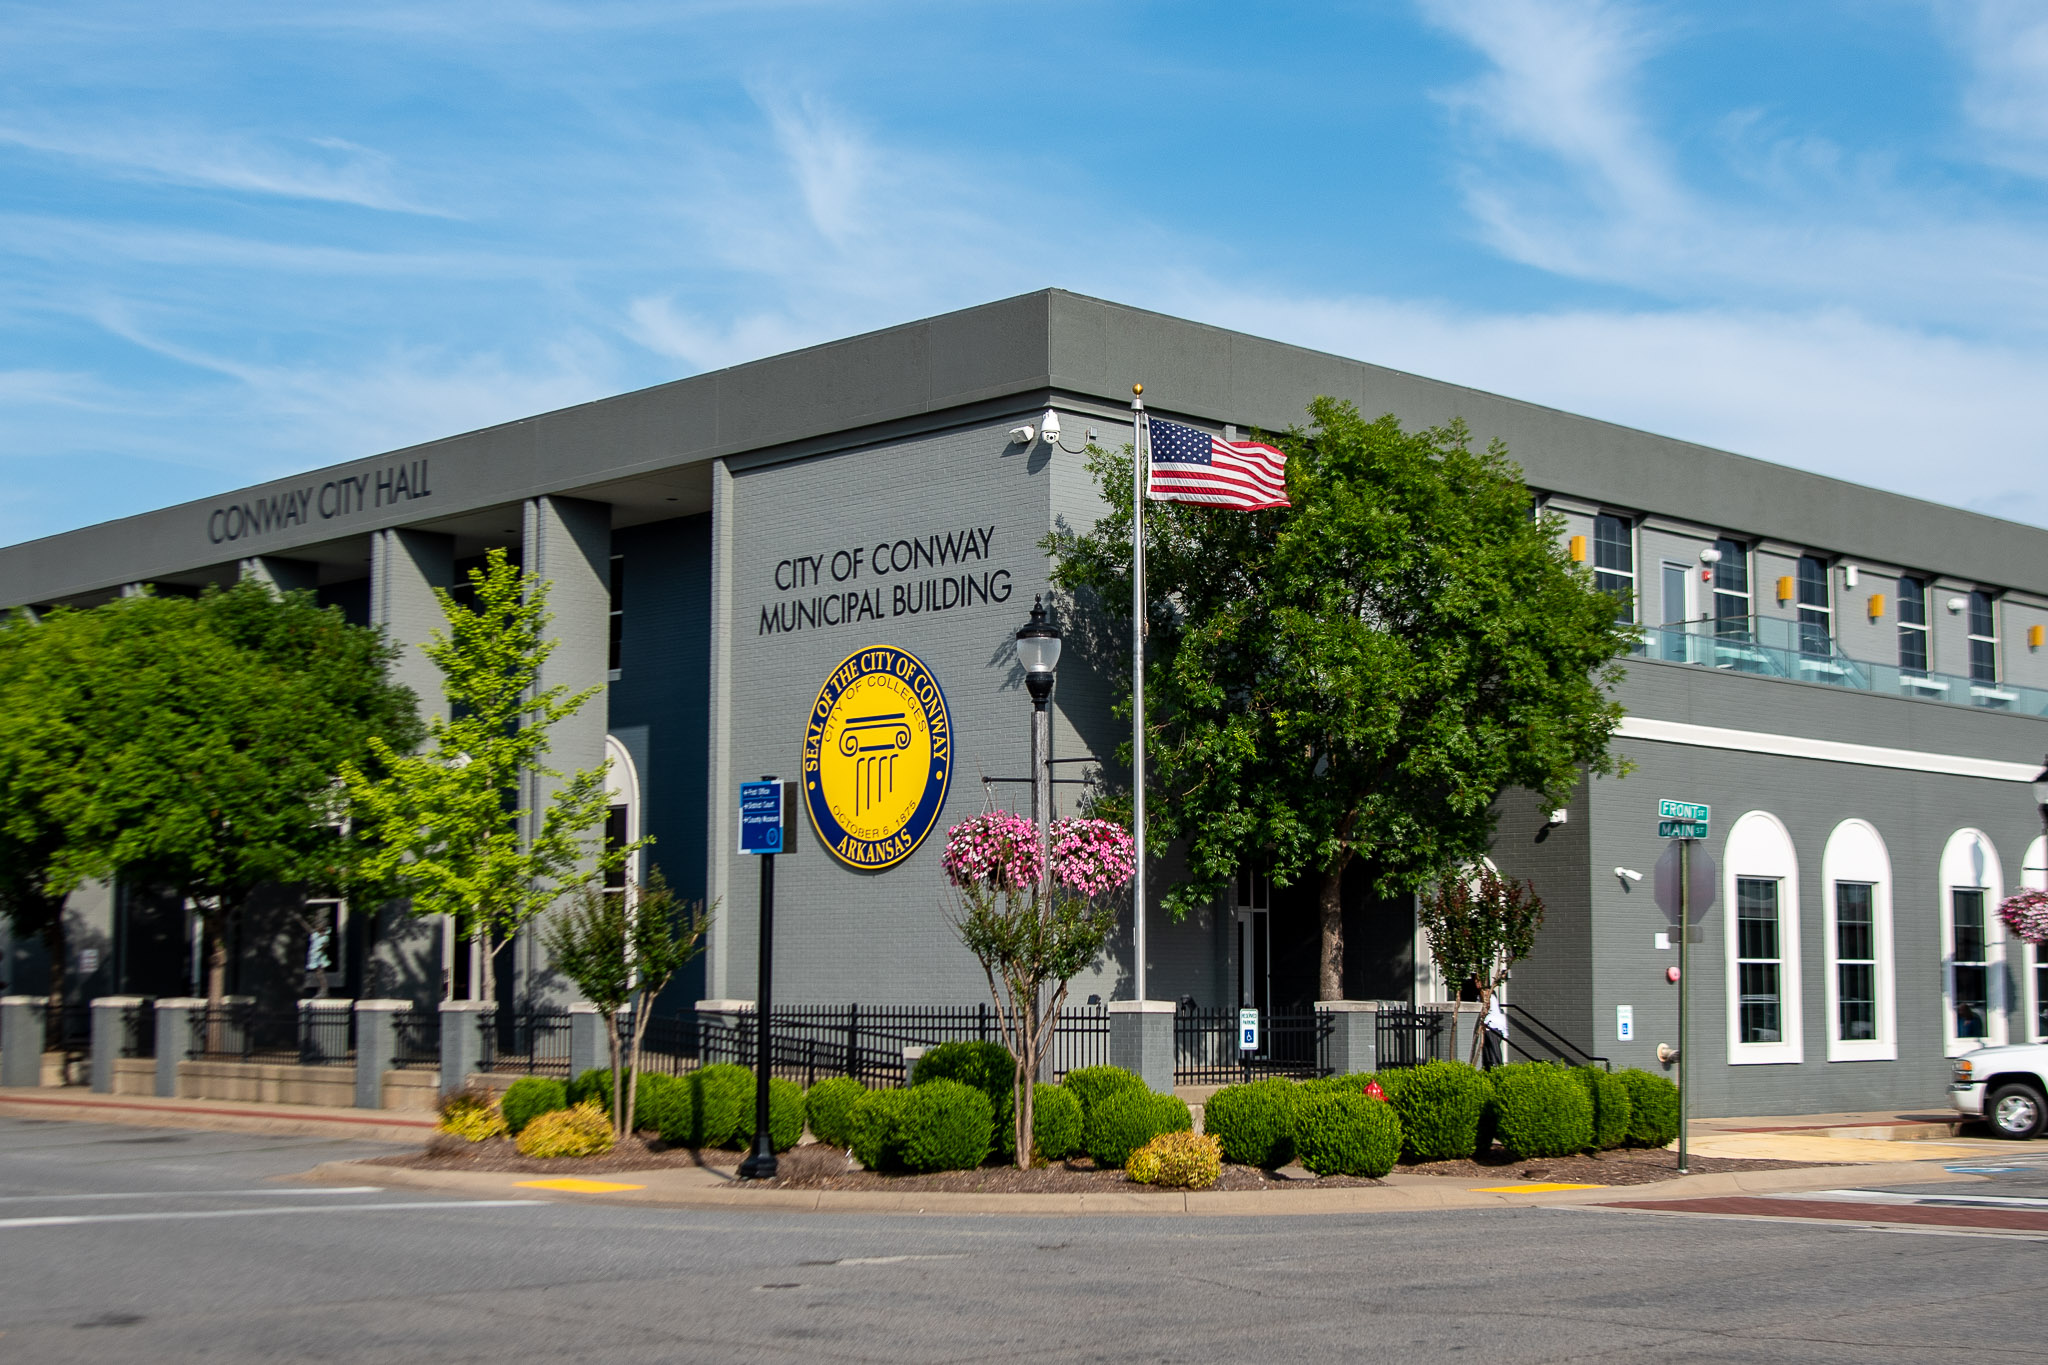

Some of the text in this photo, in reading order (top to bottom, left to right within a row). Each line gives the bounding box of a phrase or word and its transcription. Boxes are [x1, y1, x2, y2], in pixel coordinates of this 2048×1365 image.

[208, 459, 432, 544] CONWAY CITY HALL
[775, 525, 995, 591] CITY OF CONWAY
[759, 569, 1012, 636] MUNICIPAL BUILDING
[805, 651, 948, 772] SEAL OF THE CITY OF CONWAY
[824, 675, 927, 743] CITY OF COLLEGES
[833, 805, 880, 839] OCTOBER
[895, 800, 916, 827] 1875
[1661, 823, 1695, 837] MAIN
[1662, 802, 1706, 819] FRONT ST
[836, 827, 912, 863] ARKANSAS
